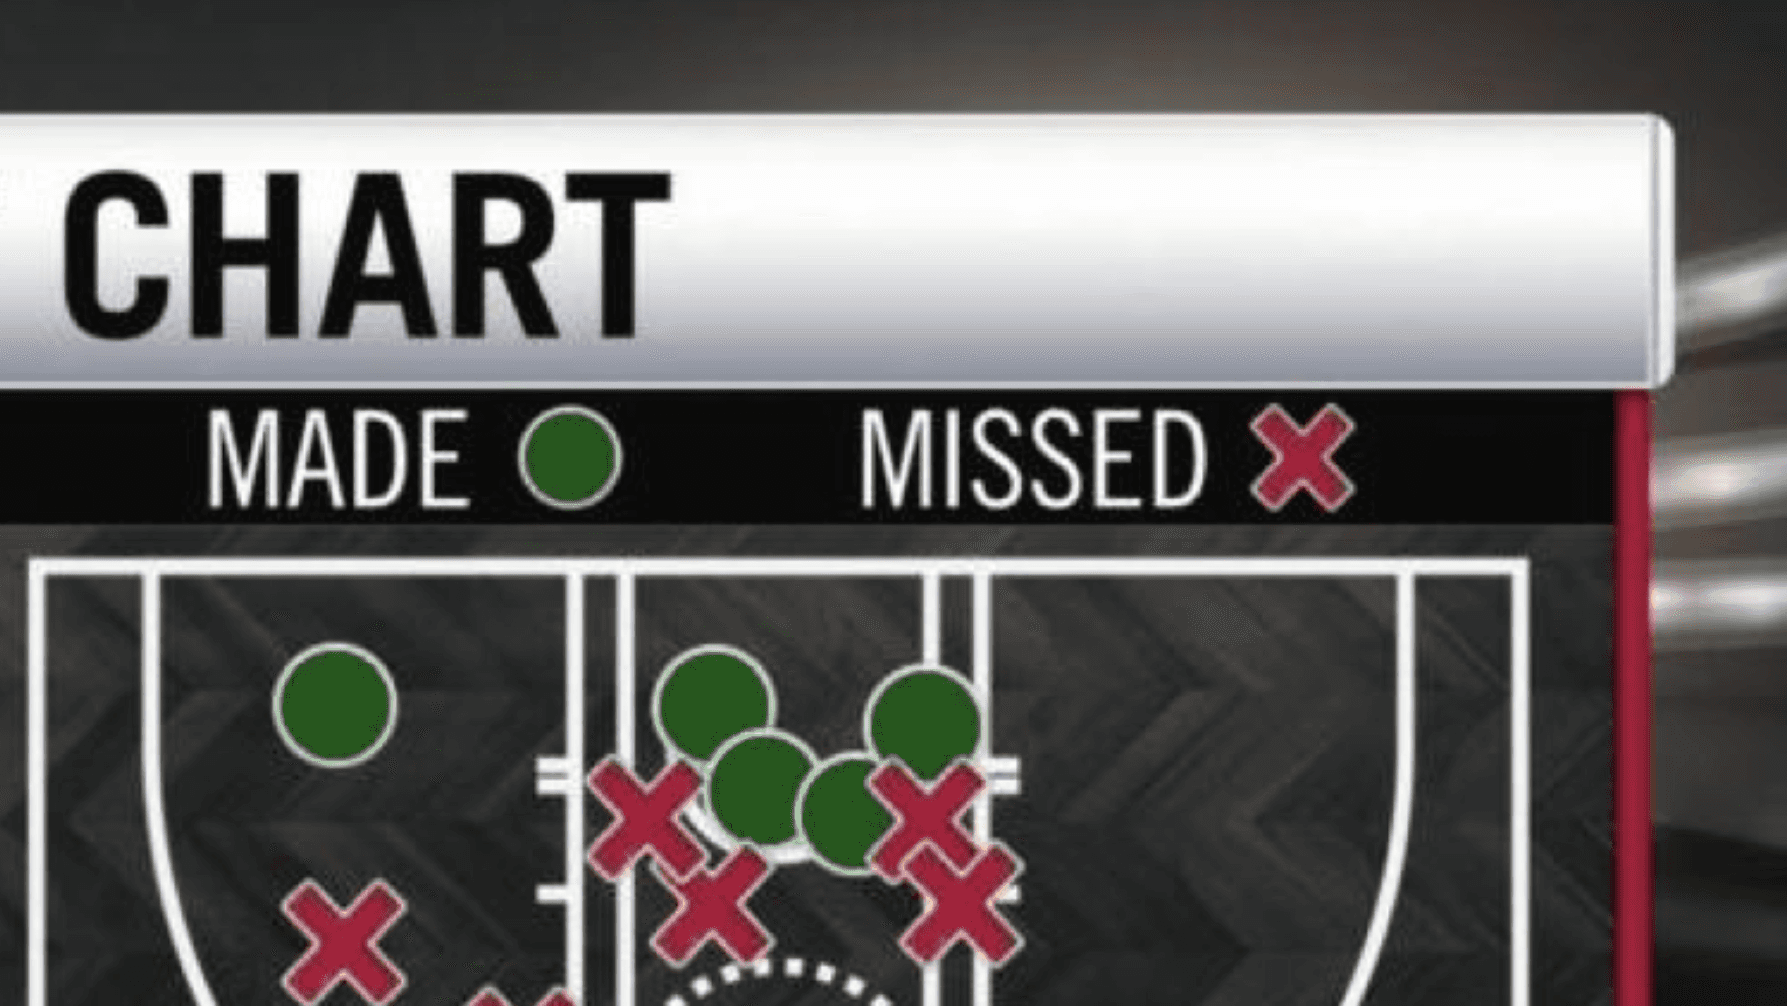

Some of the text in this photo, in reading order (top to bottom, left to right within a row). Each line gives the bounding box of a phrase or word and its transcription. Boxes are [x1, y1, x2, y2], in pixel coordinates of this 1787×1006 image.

[63, 170, 672, 342] CHART
[208, 408, 471, 509] MADE
[861, 406, 1209, 511] MISSED
